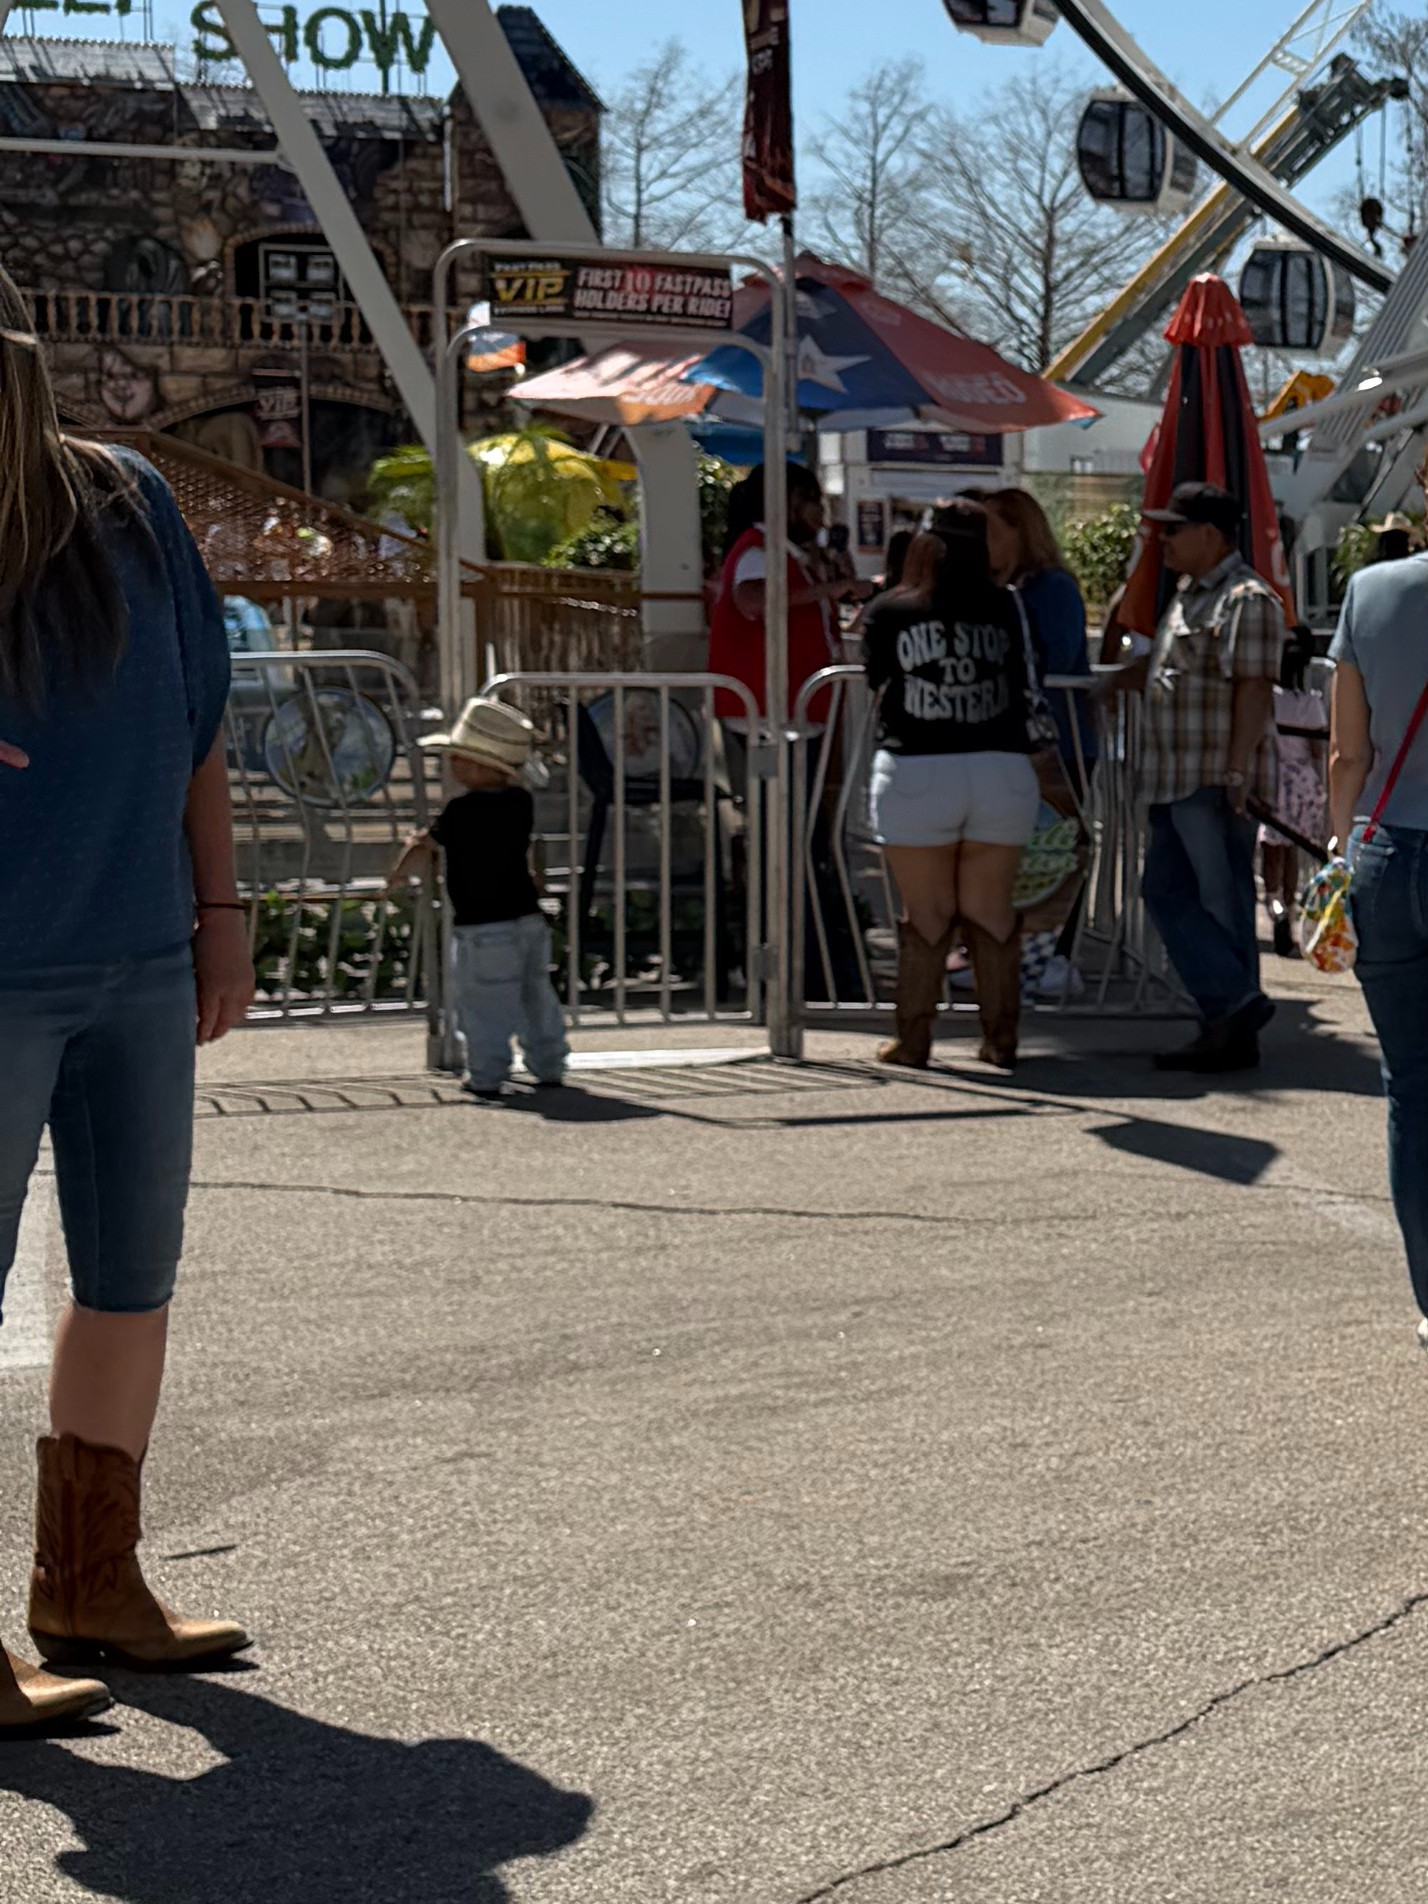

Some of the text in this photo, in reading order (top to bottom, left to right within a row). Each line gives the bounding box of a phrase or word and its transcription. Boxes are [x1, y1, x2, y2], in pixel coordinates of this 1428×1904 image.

[494, 276, 565, 302] VIP
[577, 265, 732, 297] FIRST 10 FASTPASS
[573, 288, 650, 313] HOLDERS
[651, 294, 683, 315] PER
[687, 298, 732, 319] RIDE!
[896, 619, 1012, 673] ONE STOP
[938, 656, 977, 684] TO
